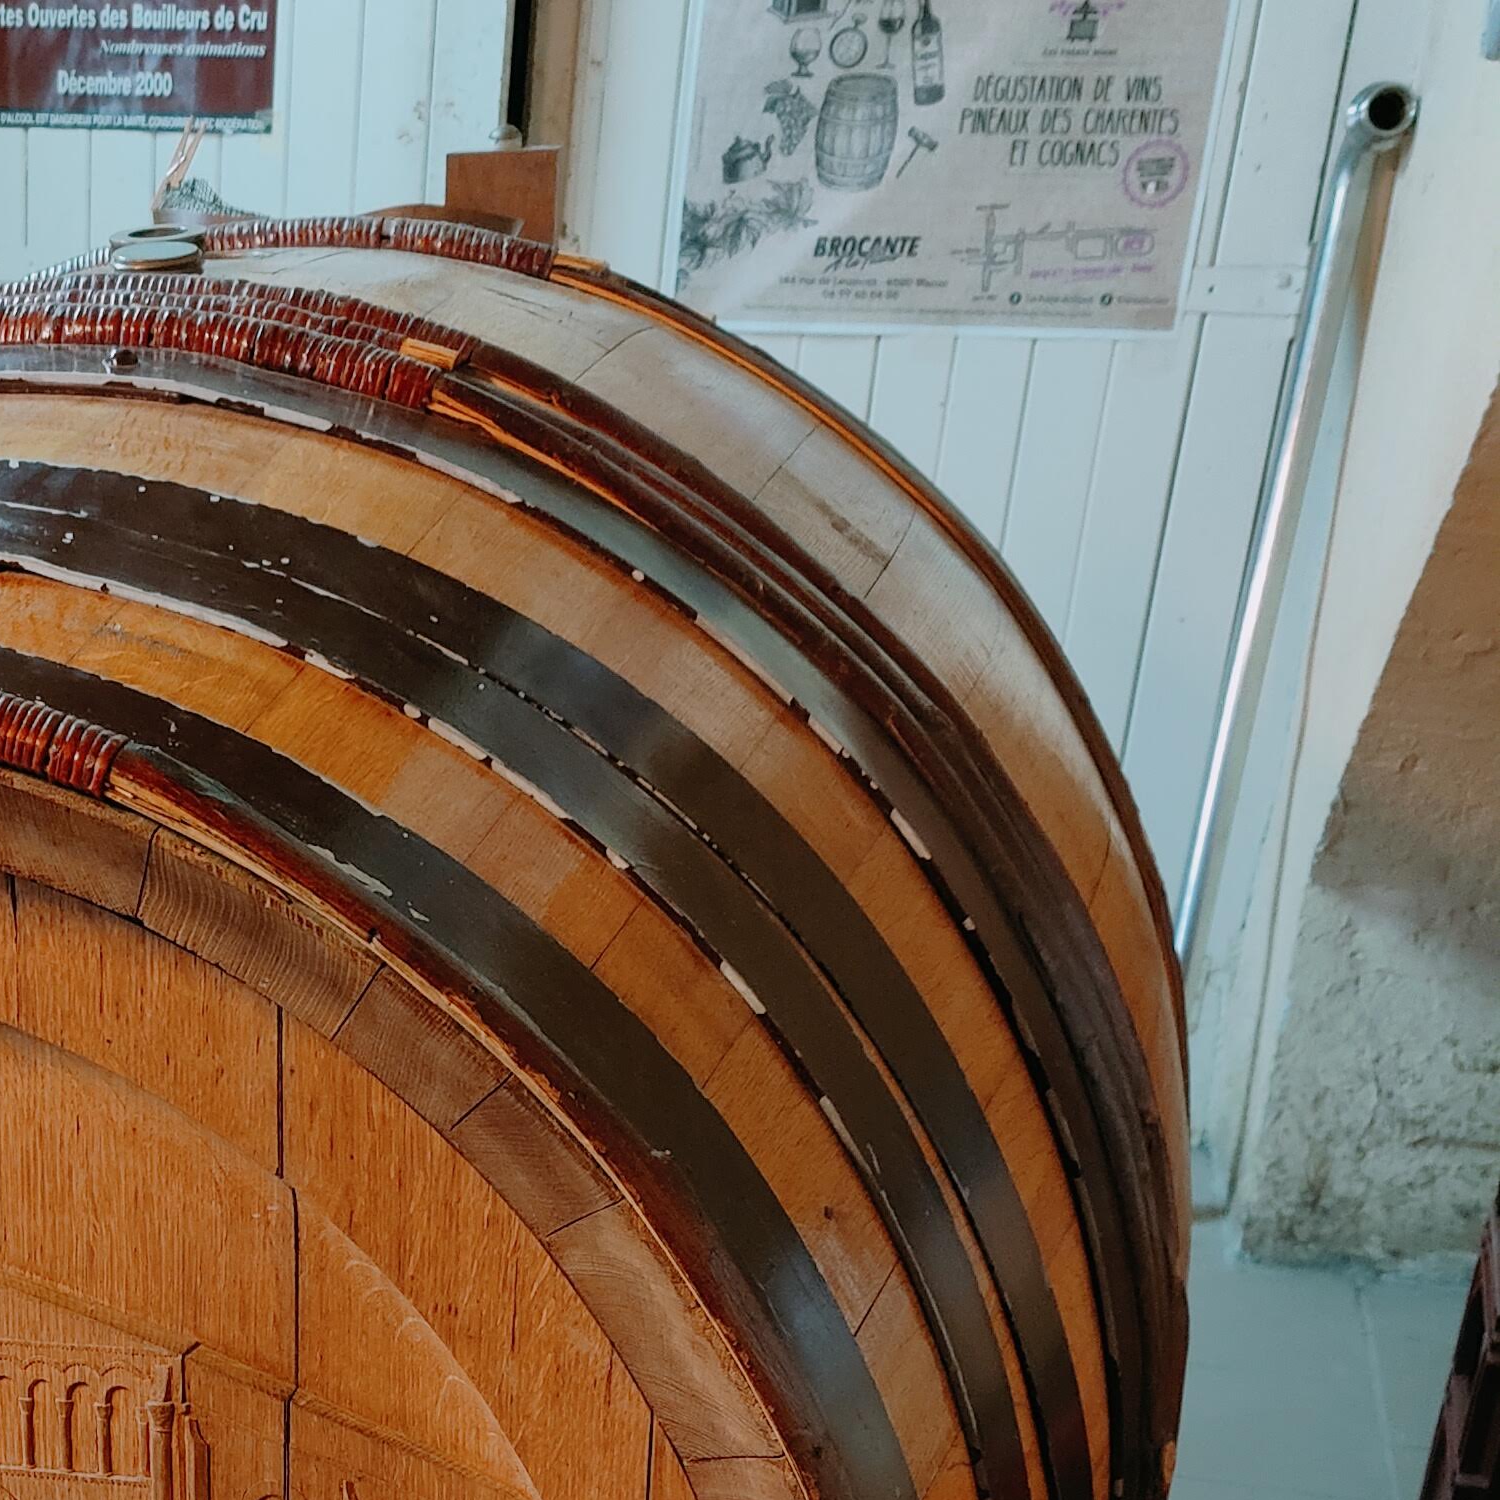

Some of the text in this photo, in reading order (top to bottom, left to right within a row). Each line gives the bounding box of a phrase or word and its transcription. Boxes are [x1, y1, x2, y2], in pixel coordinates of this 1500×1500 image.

[28, 3, 97, 29] Ouvertes
[101, 5, 128, 30] des
[132, 4, 210, 31] Bouilleurs
[214, 7, 235, 30] de
[238, 6, 268, 31] Cru
[100, 39, 267, 58] Nombreuses animations
[57, 69, 173, 97] Décembre 2000
[974, 73, 1084, 101] DÉGUSTATION
[1094, 75, 1114, 101] DE
[959, 107, 1030, 134] PINEAUX
[1041, 107, 1073, 134] DES
[1009, 140, 1029, 166] ET
[1037, 140, 1121, 167] COGNACS
[814, 235, 922, 257] BROCANTE
